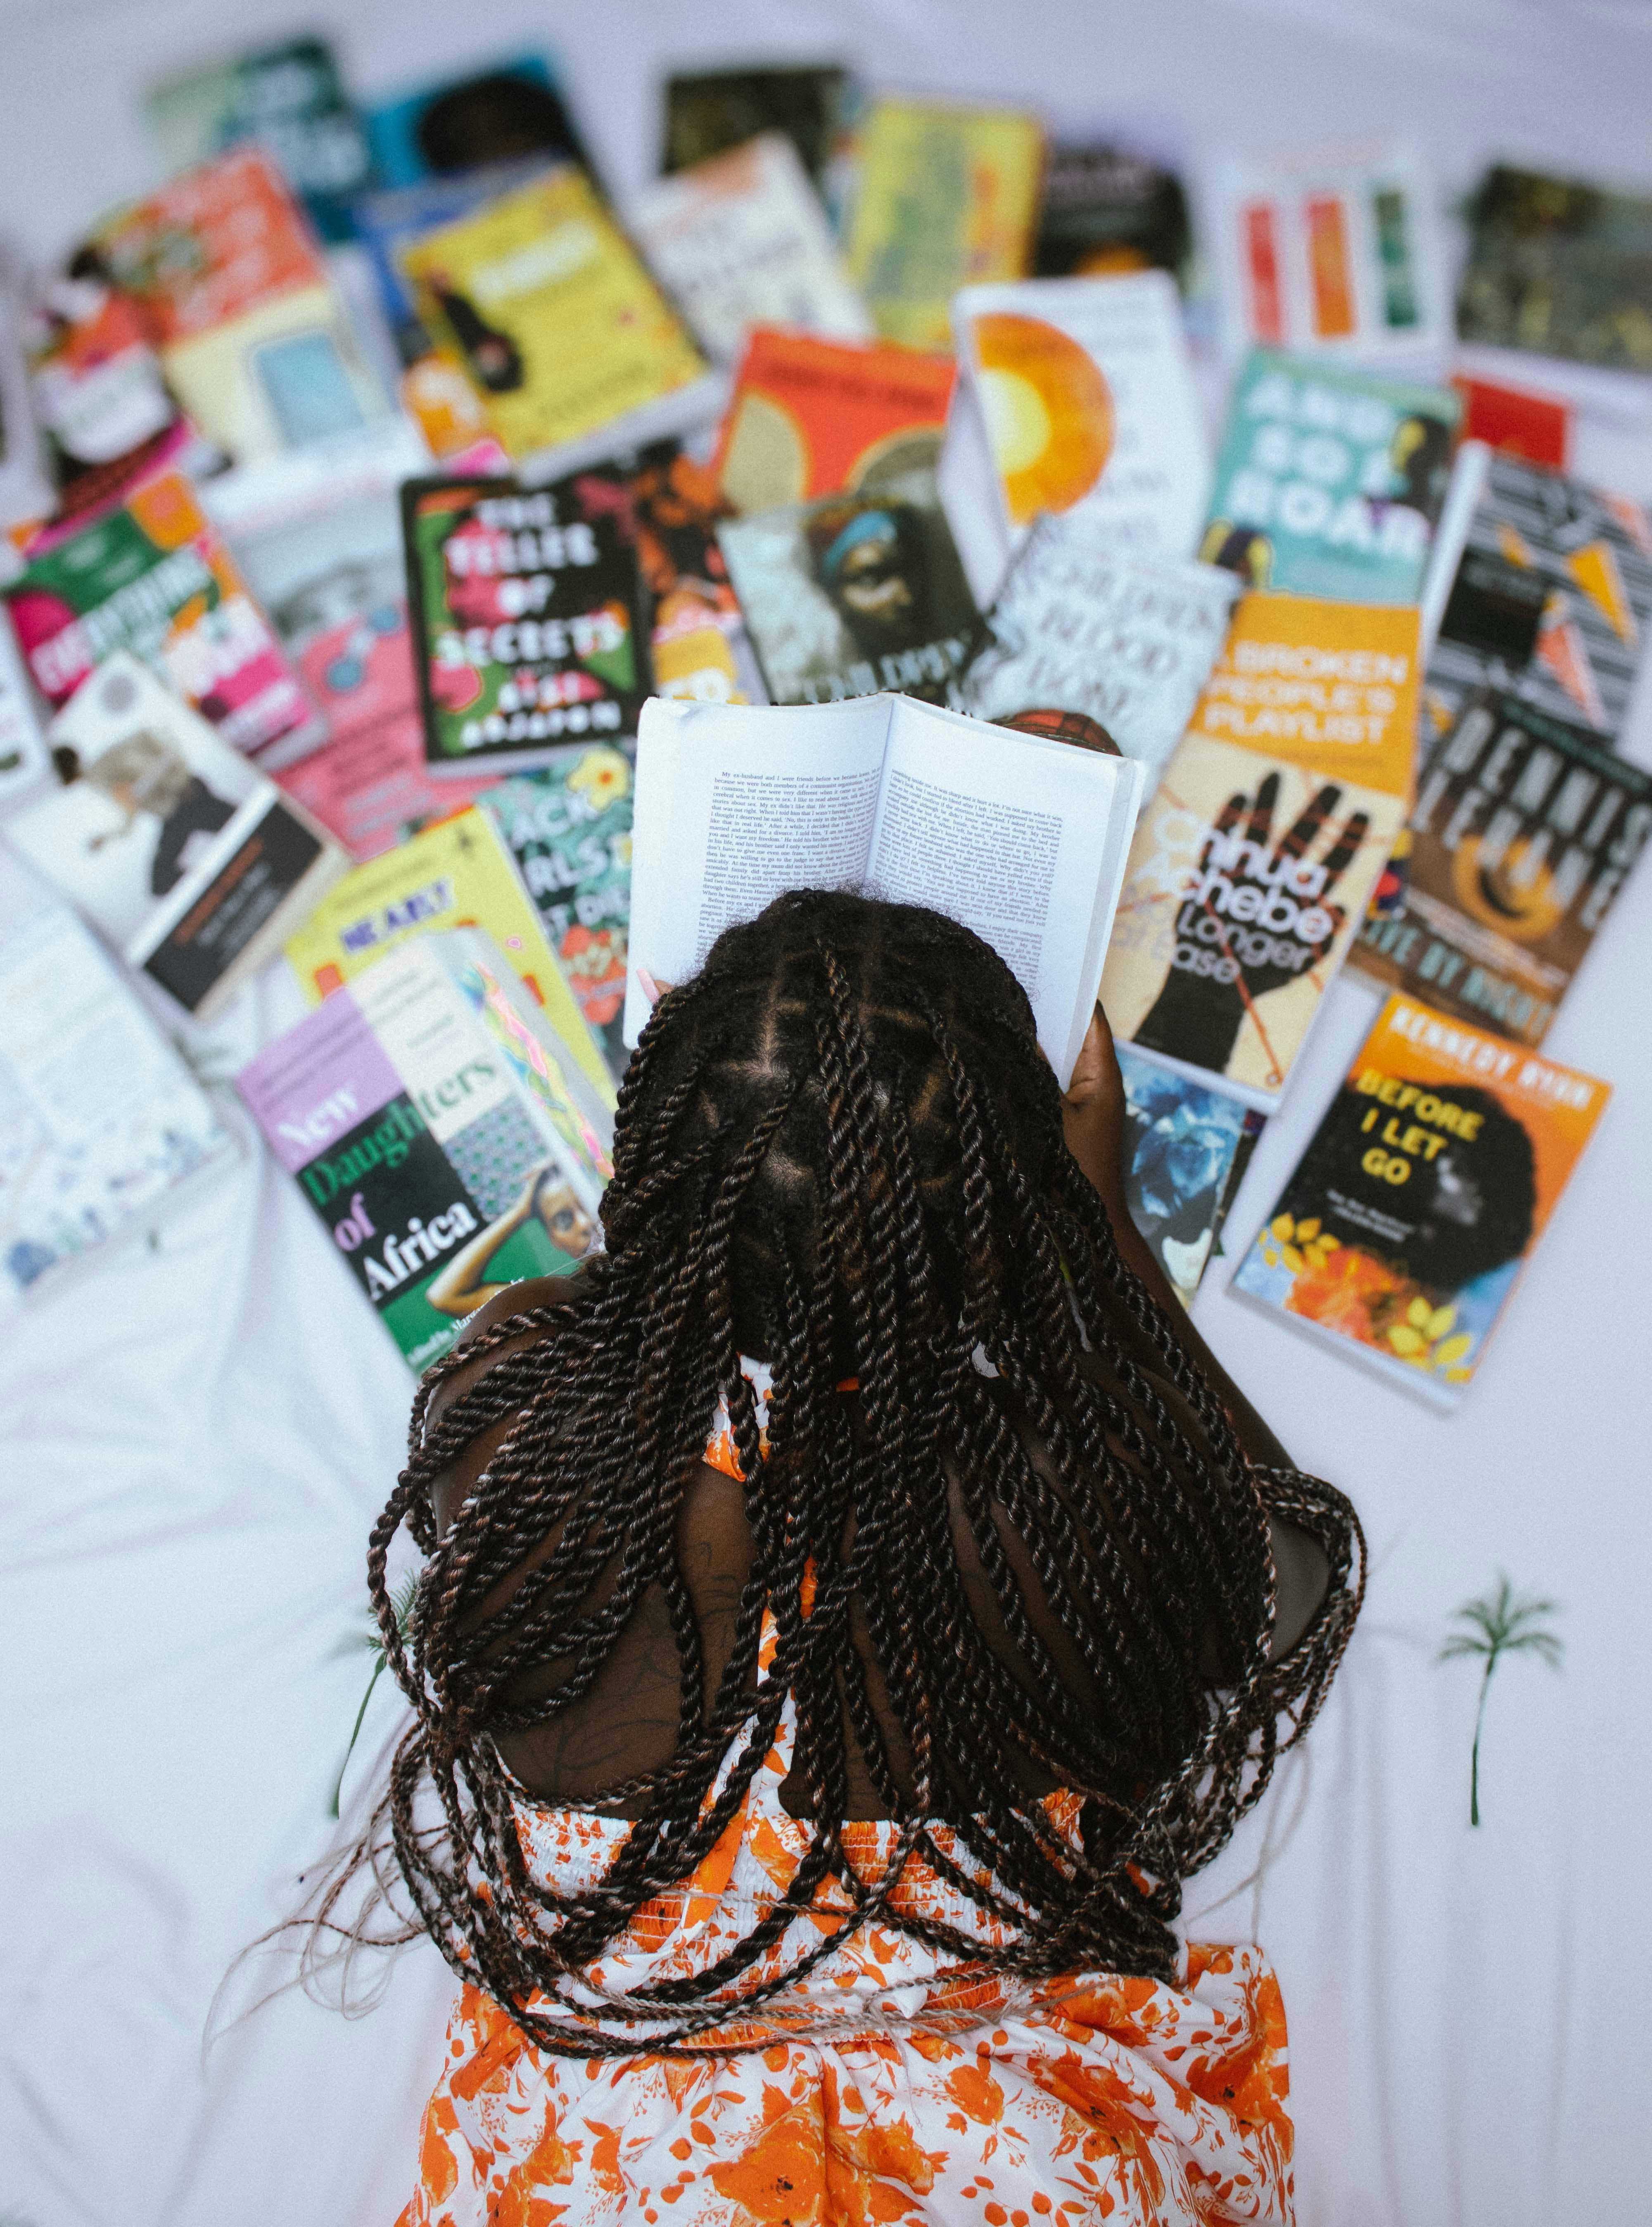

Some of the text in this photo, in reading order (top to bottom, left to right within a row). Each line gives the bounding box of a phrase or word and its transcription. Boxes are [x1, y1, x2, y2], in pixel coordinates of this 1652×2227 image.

[445, 523, 597, 577] TELLER
[498, 574, 555, 615] OF
[435, 611, 624, 671] SECRETS
[1234, 639, 1408, 685] BROKEN
[499, 668, 579, 712] BISI
[1204, 704, 1390, 747] PLAYLIST
[927, 791, 942, 799] started
[948, 797, 961, 805] bleed
[949, 791, 961, 800] sharp
[954, 807, 974, 815] abortion
[1442, 705, 1652, 866] DENNIS
[1152, 807, 1329, 897] Chinua
[1132, 851, 1333, 944] Achebe
[1150, 929, 1241, 985] Ease
[1176, 904, 1313, 971] Longer
[1356, 917, 1422, 965] IVE
[1417, 940, 1466, 989] BY
[1388, 1005, 1517, 1082] KENNEDY
[277, 1086, 359, 1147] New
[302, 1060, 494, 1205] Daughters
[1355, 1068, 1484, 1142] BEFORE
[1360, 1107, 1449, 1161] I LET
[1361, 1146, 1413, 1186] GO
[334, 1192, 377, 1252] of
[362, 1201, 478, 1301] Africa
